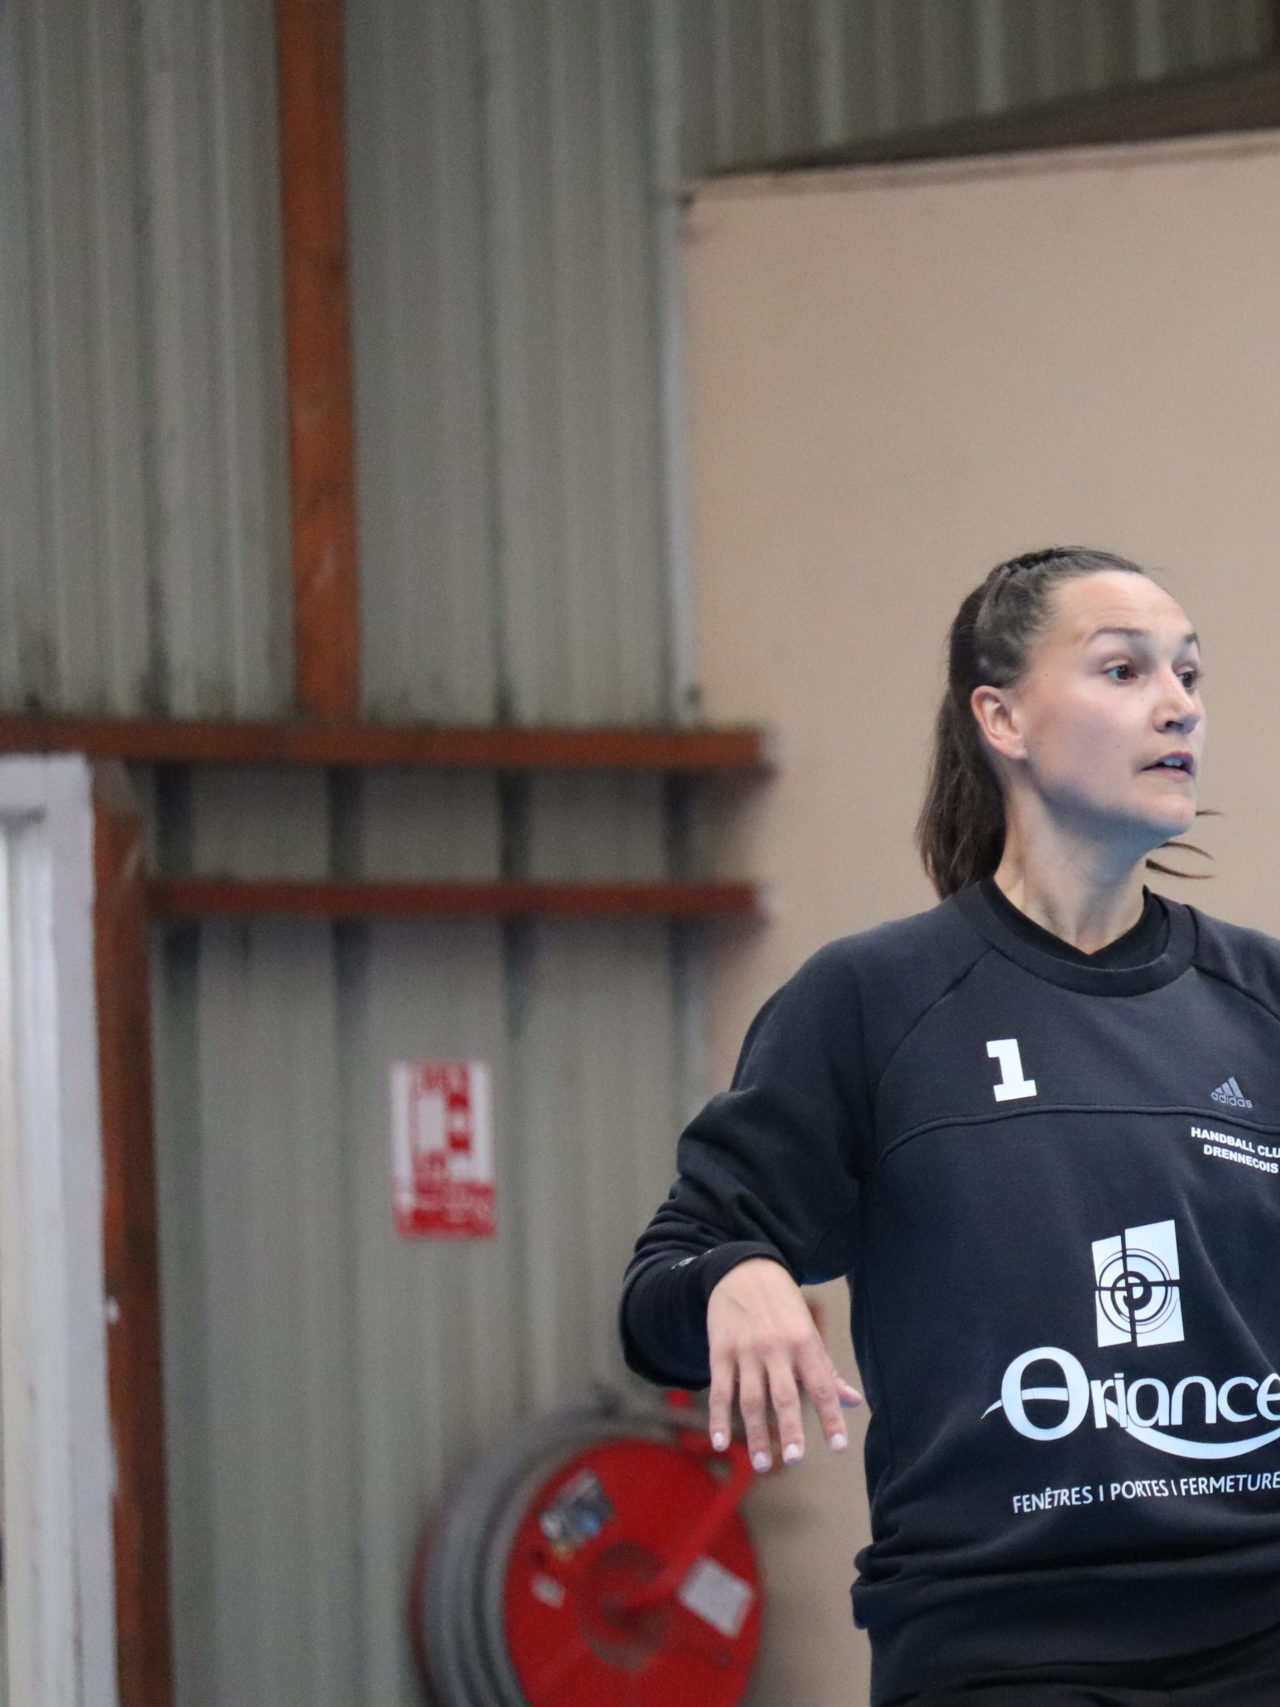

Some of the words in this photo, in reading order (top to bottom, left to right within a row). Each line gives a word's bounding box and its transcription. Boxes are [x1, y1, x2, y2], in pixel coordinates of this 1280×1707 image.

[986, 1038, 1037, 1102] 1
[1210, 1091, 1253, 1108] adidas
[1190, 1127, 1255, 1153] HANDBALL
[1203, 1144, 1279, 1174] DRENNECOIS
[1012, 1486, 1094, 1514] FENÊTRES
[1110, 1480, 1169, 1501] PORTES
